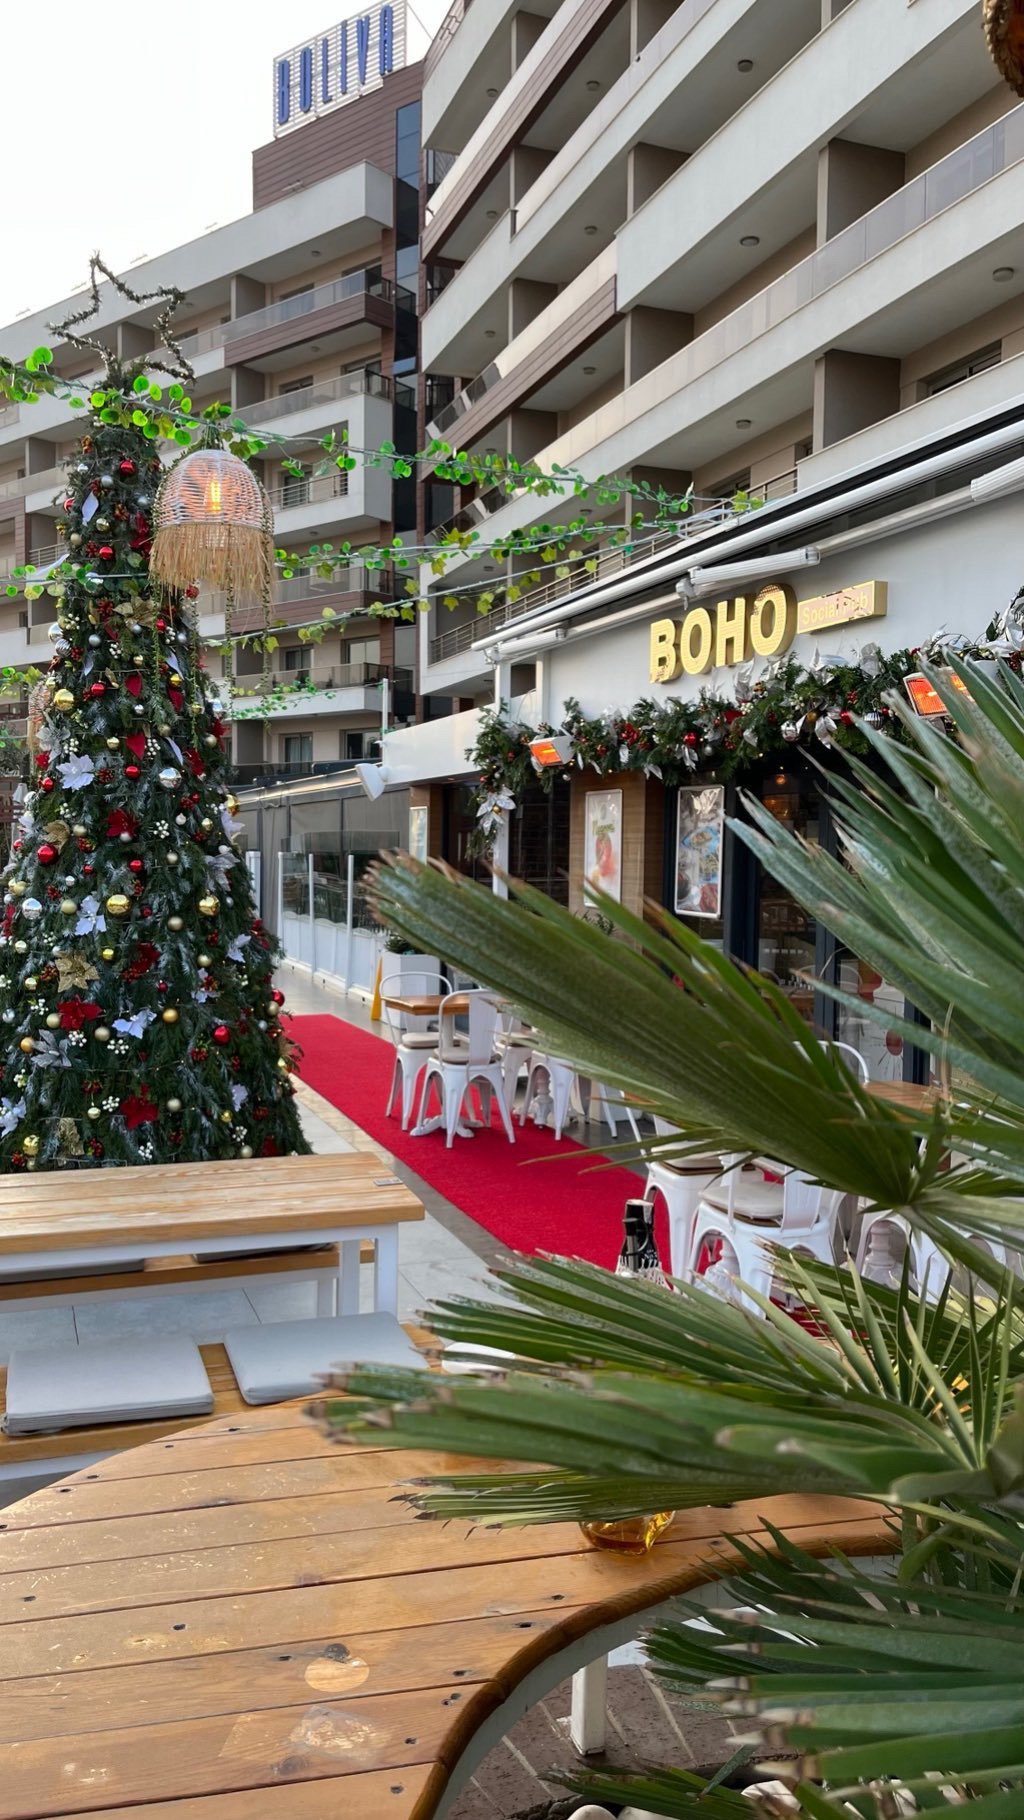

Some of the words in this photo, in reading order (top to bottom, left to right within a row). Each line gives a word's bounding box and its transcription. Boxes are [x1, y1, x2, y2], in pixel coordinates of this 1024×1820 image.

[278, 5, 393, 125] BOLIVA
[650, 584, 794, 683] BOHO
[802, 597, 839, 625] Social
